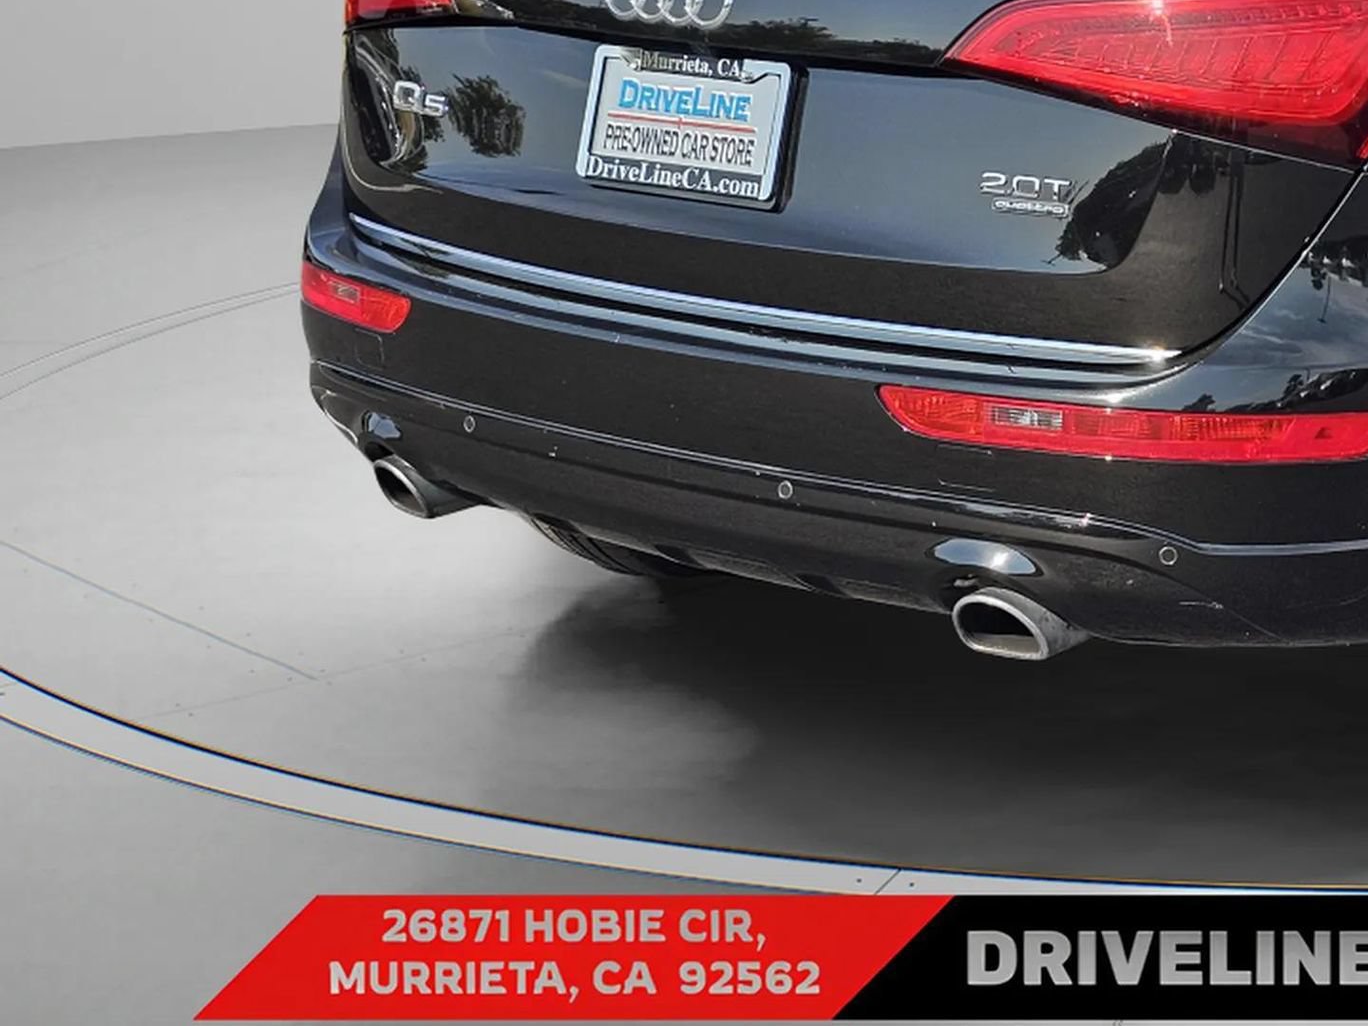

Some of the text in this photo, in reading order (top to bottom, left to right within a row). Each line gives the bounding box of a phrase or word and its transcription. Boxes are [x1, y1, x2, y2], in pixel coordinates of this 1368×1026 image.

[641, 50, 740, 77] Murrieta, CA
[394, 81, 446, 116] Q5
[604, 124, 755, 167] PRE-OWNED CAR STORE
[586, 155, 759, 198] DriveLineCA.com
